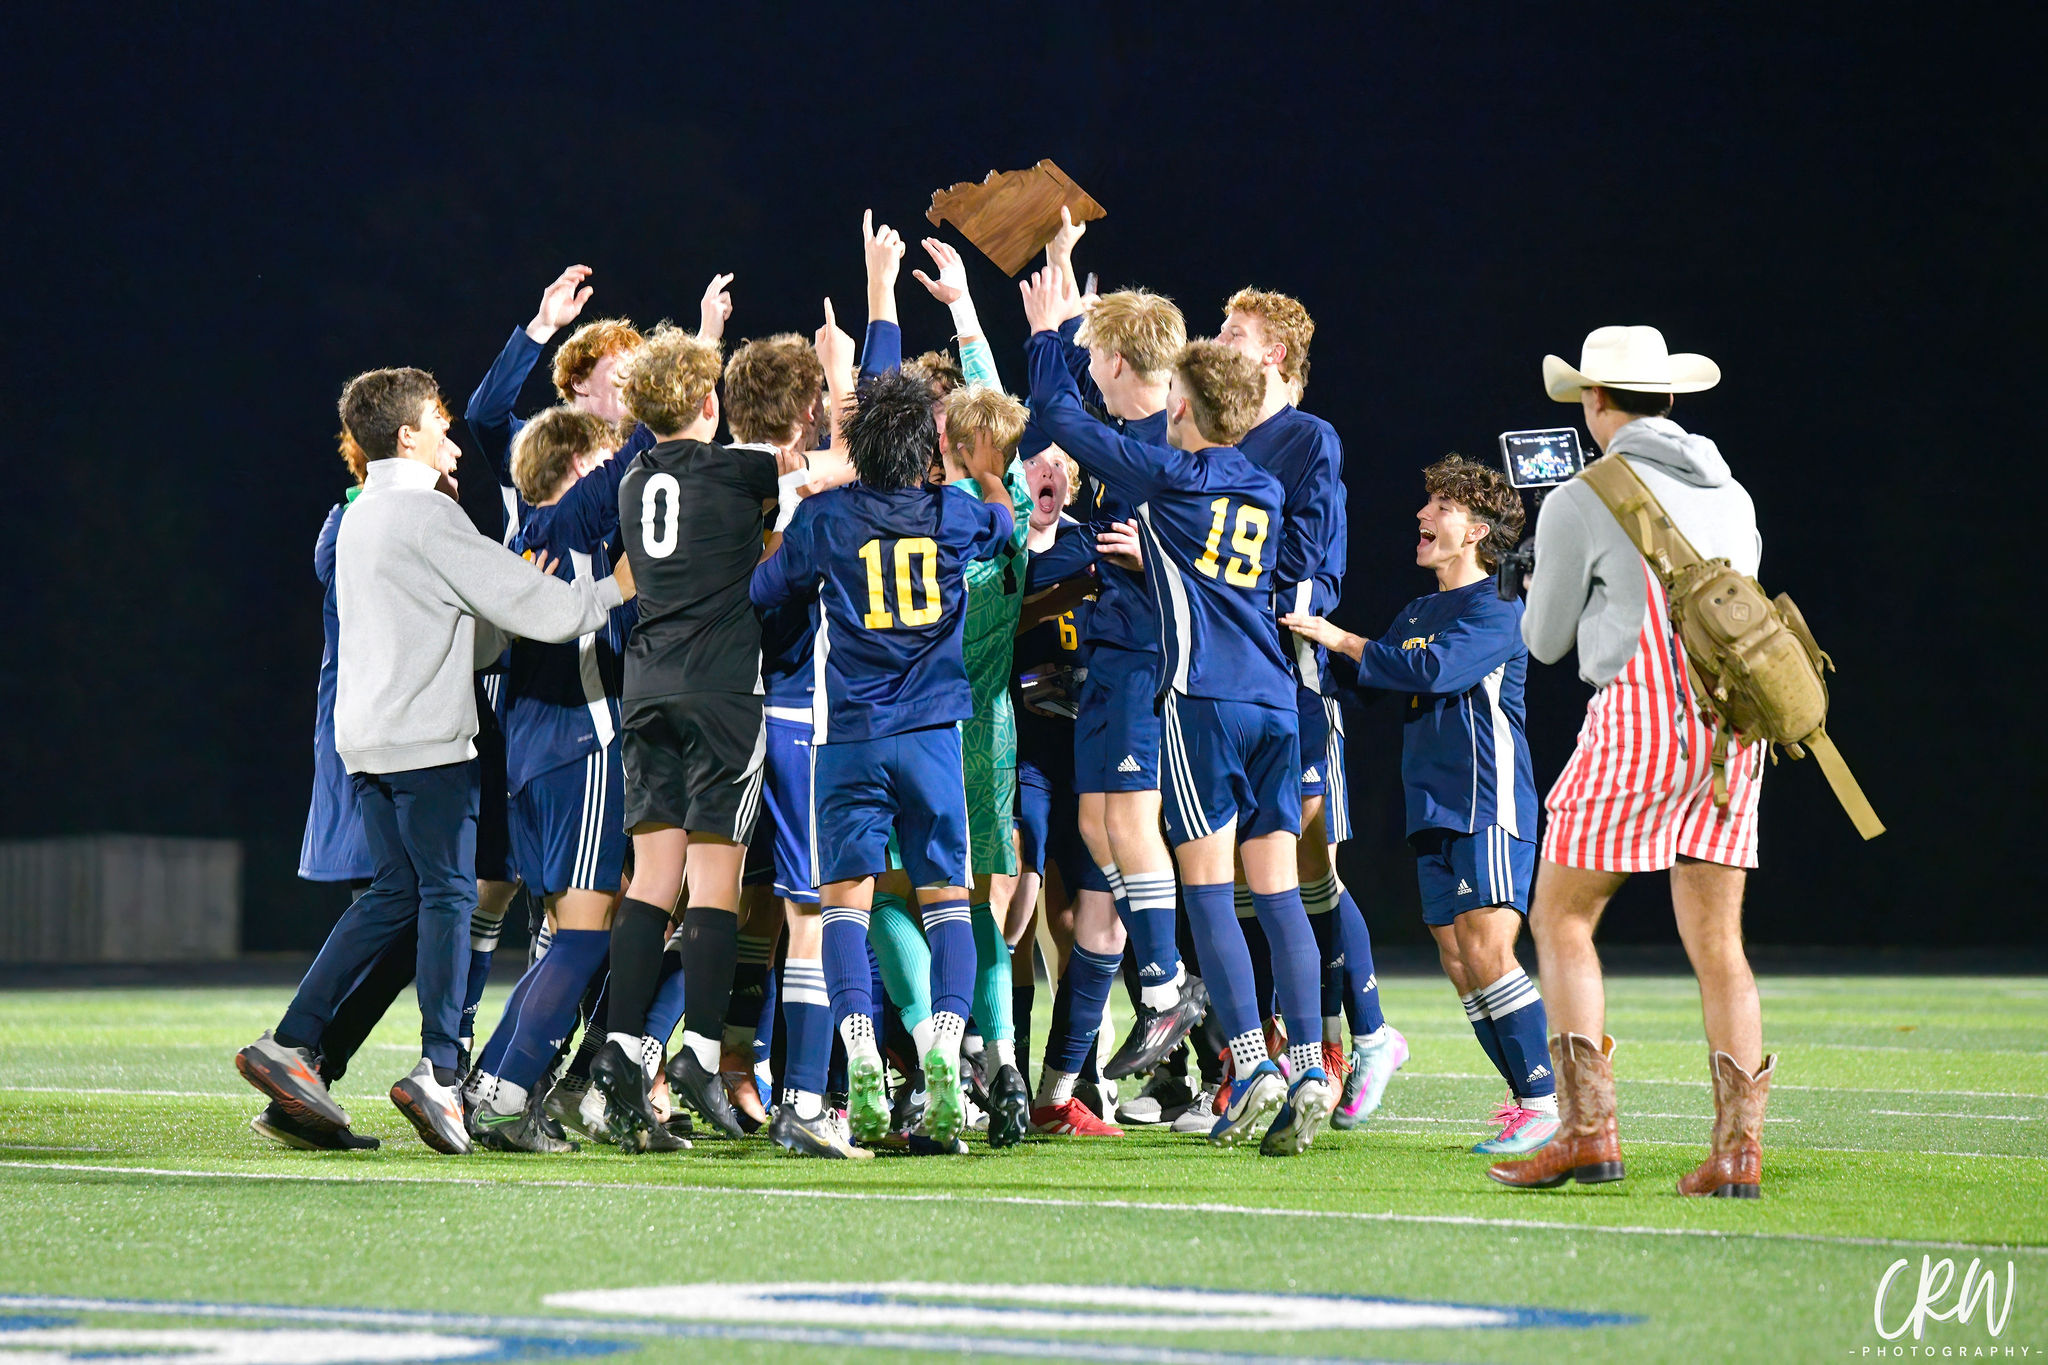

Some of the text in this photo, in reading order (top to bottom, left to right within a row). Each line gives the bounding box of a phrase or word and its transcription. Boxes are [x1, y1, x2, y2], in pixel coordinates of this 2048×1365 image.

[641, 473, 680, 559] 0
[1194, 497, 1270, 589] 19
[858, 537, 943, 629] 10
[1058, 610, 1078, 650] 6
